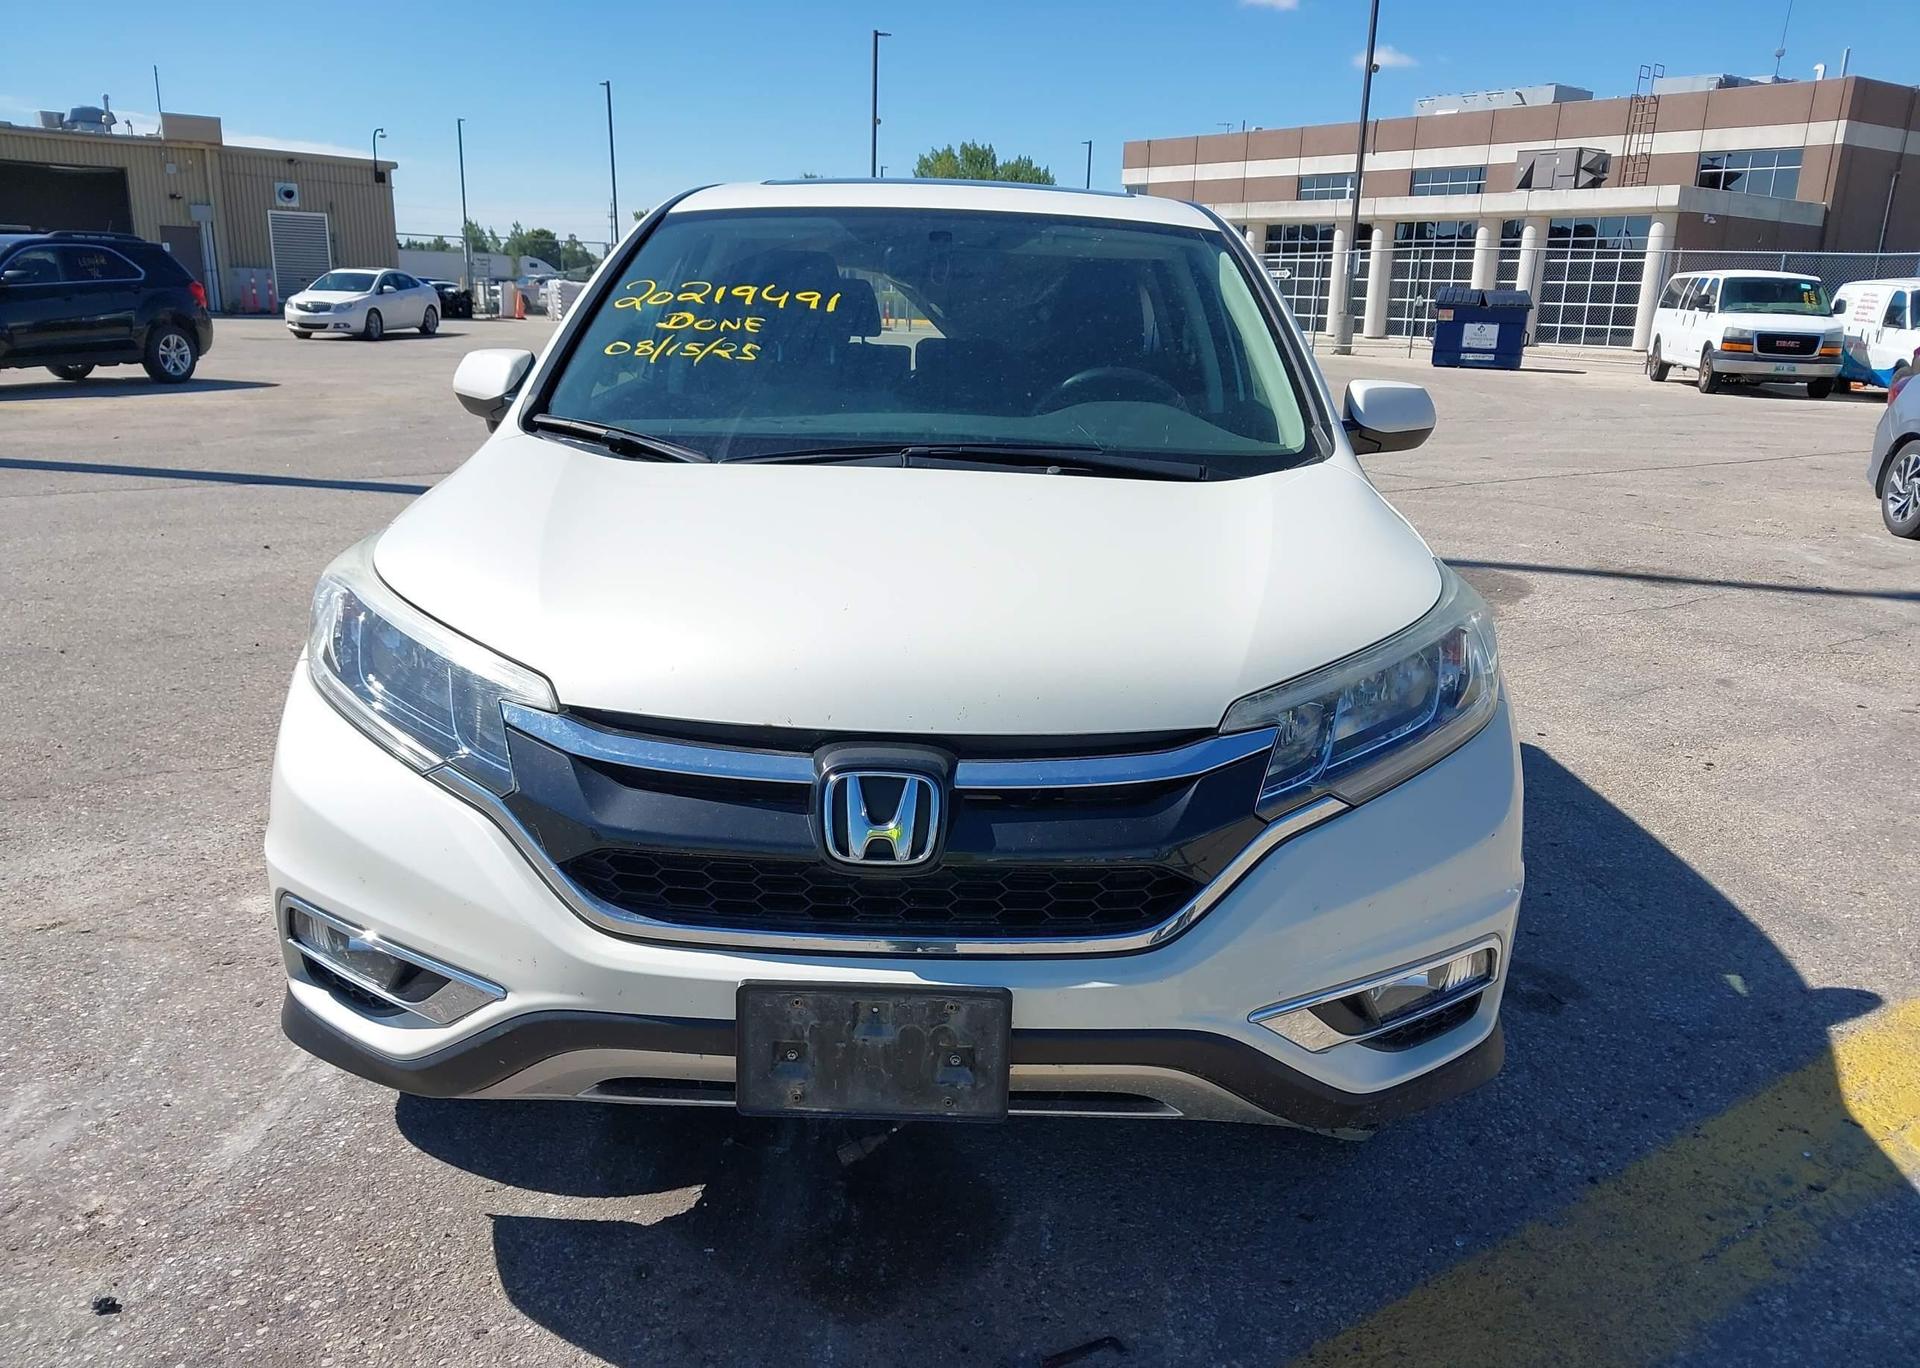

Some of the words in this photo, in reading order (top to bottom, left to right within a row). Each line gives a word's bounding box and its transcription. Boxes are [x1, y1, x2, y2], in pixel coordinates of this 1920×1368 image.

[614, 279, 842, 313] 20219491
[655, 311, 766, 333] DONE
[603, 333, 762, 367] 08/15/25
[1775, 340, 1801, 348] GMC
